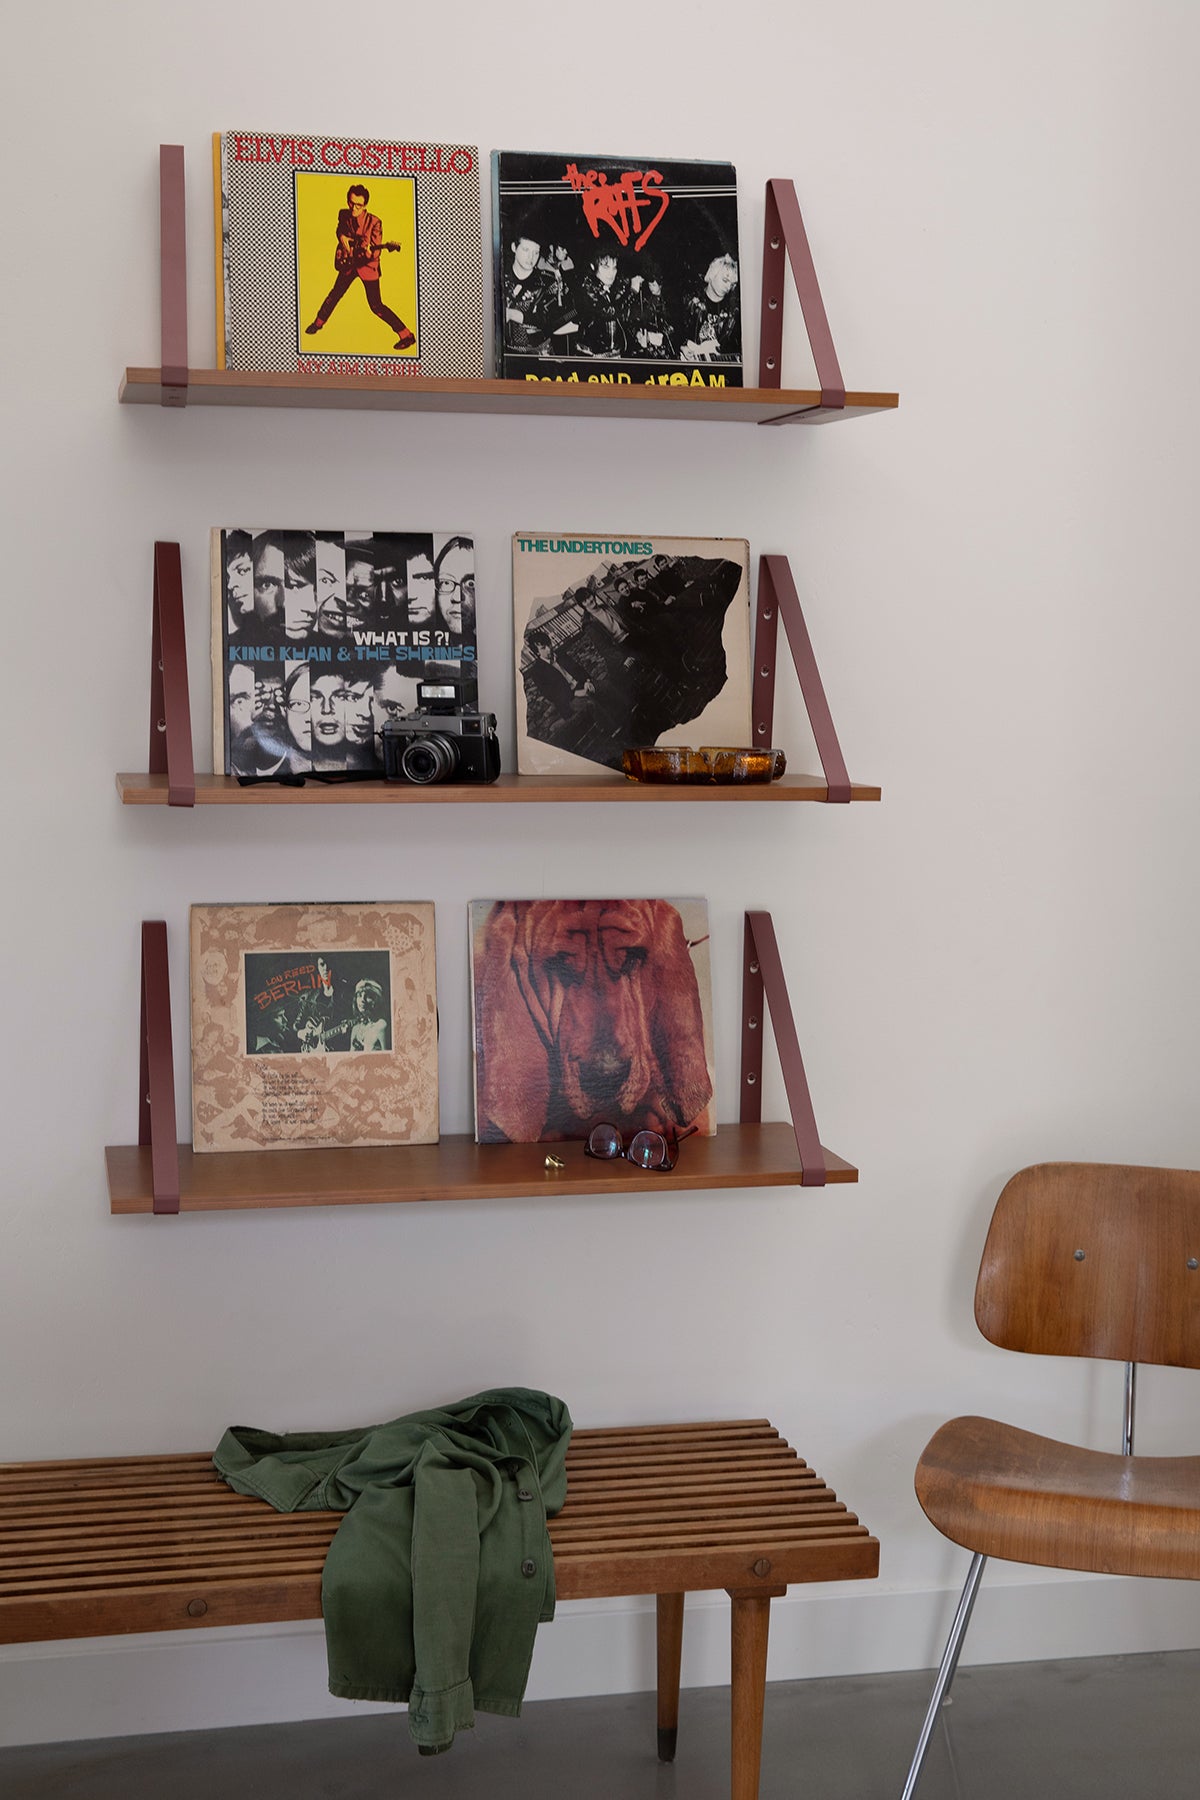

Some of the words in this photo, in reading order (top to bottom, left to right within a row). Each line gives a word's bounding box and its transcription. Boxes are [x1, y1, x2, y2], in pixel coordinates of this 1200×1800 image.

[233, 136, 315, 165] ELVIS
[321, 142, 473, 174] COSTELLO
[297, 359, 323, 374] MY
[327, 360, 360, 376] AIM
[364, 362, 379, 376] IS
[517, 539, 549, 552] THE
[549, 540, 653, 555] UNDERTONES
[353, 630, 408, 646] WHAT
[412, 631, 430, 646] IS
[434, 631, 450, 646] ?!
[229, 646, 275, 661] KING
[279, 646, 332, 662] KHAN
[337, 646, 351, 661] &
[355, 646, 390, 660] THE
[395, 646, 475, 661] SHRINES
[266, 975, 283, 986] LOU
[284, 965, 315, 979] REED
[254, 969, 332, 1010] BERLIN
